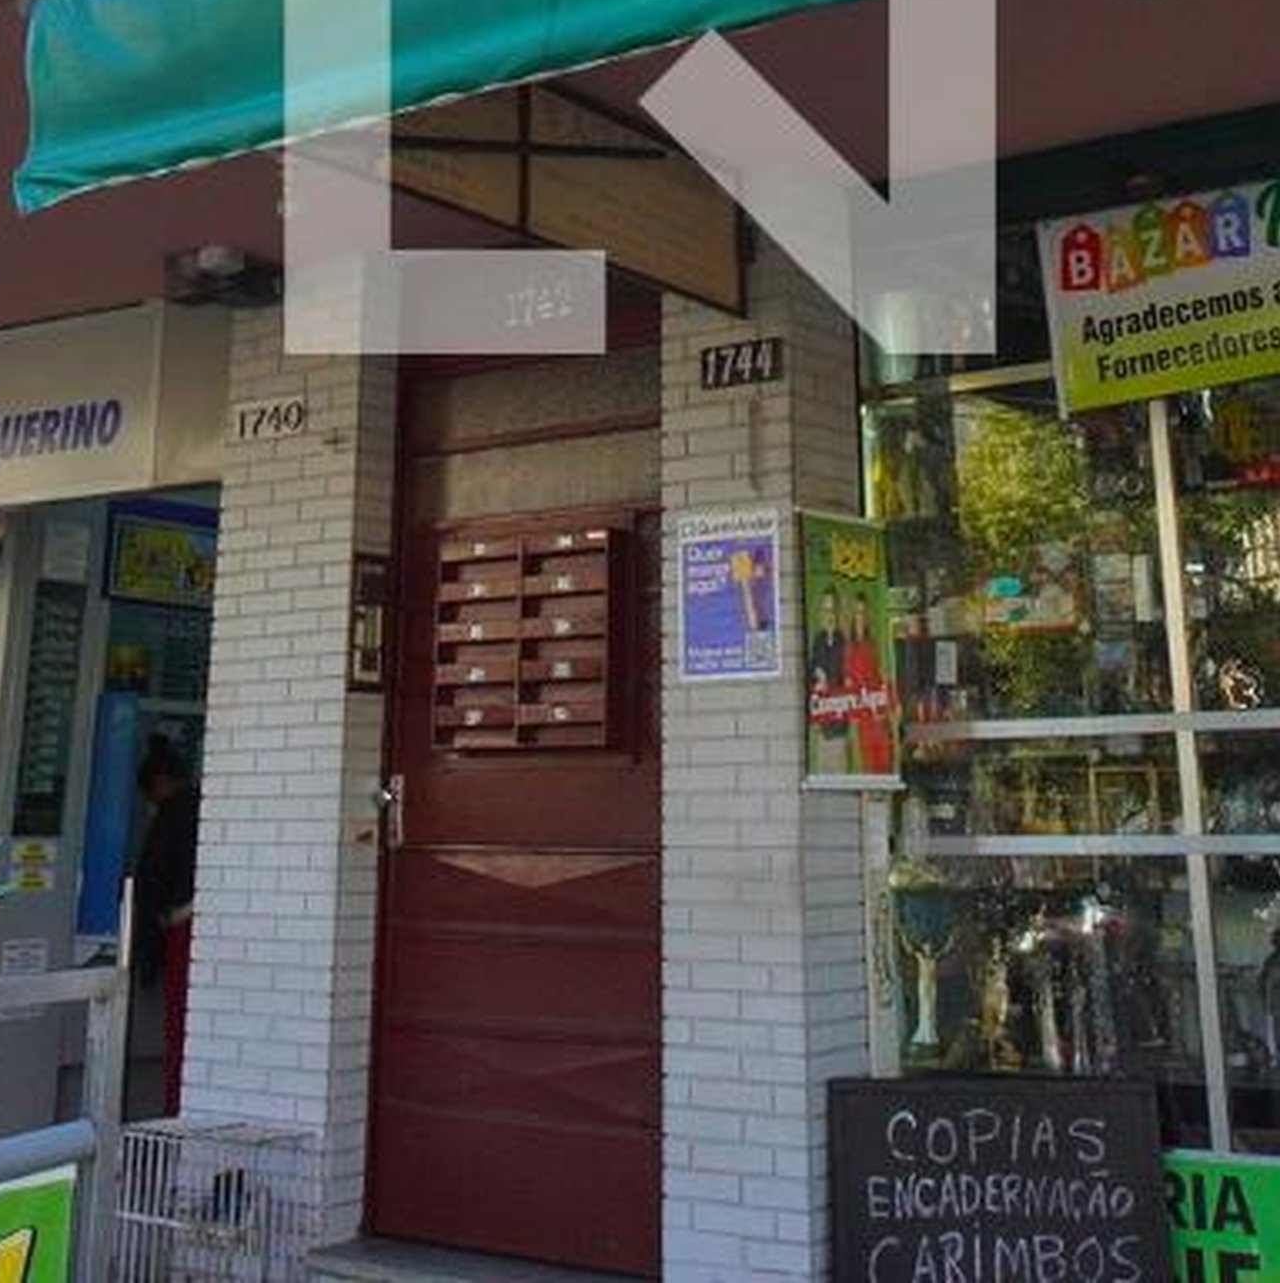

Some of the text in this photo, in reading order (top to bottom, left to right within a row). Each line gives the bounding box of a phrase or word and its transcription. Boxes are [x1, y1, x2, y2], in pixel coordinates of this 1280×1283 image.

[1064, 204, 1250, 290] BAZAR
[1081, 282, 1265, 346] Agradecemos
[706, 339, 773, 385] 1744
[239, 400, 303, 438] 1740
[886, 1108, 1107, 1165] COPIAS
[868, 1168, 1135, 1222] ENCADERNAÇÃO
